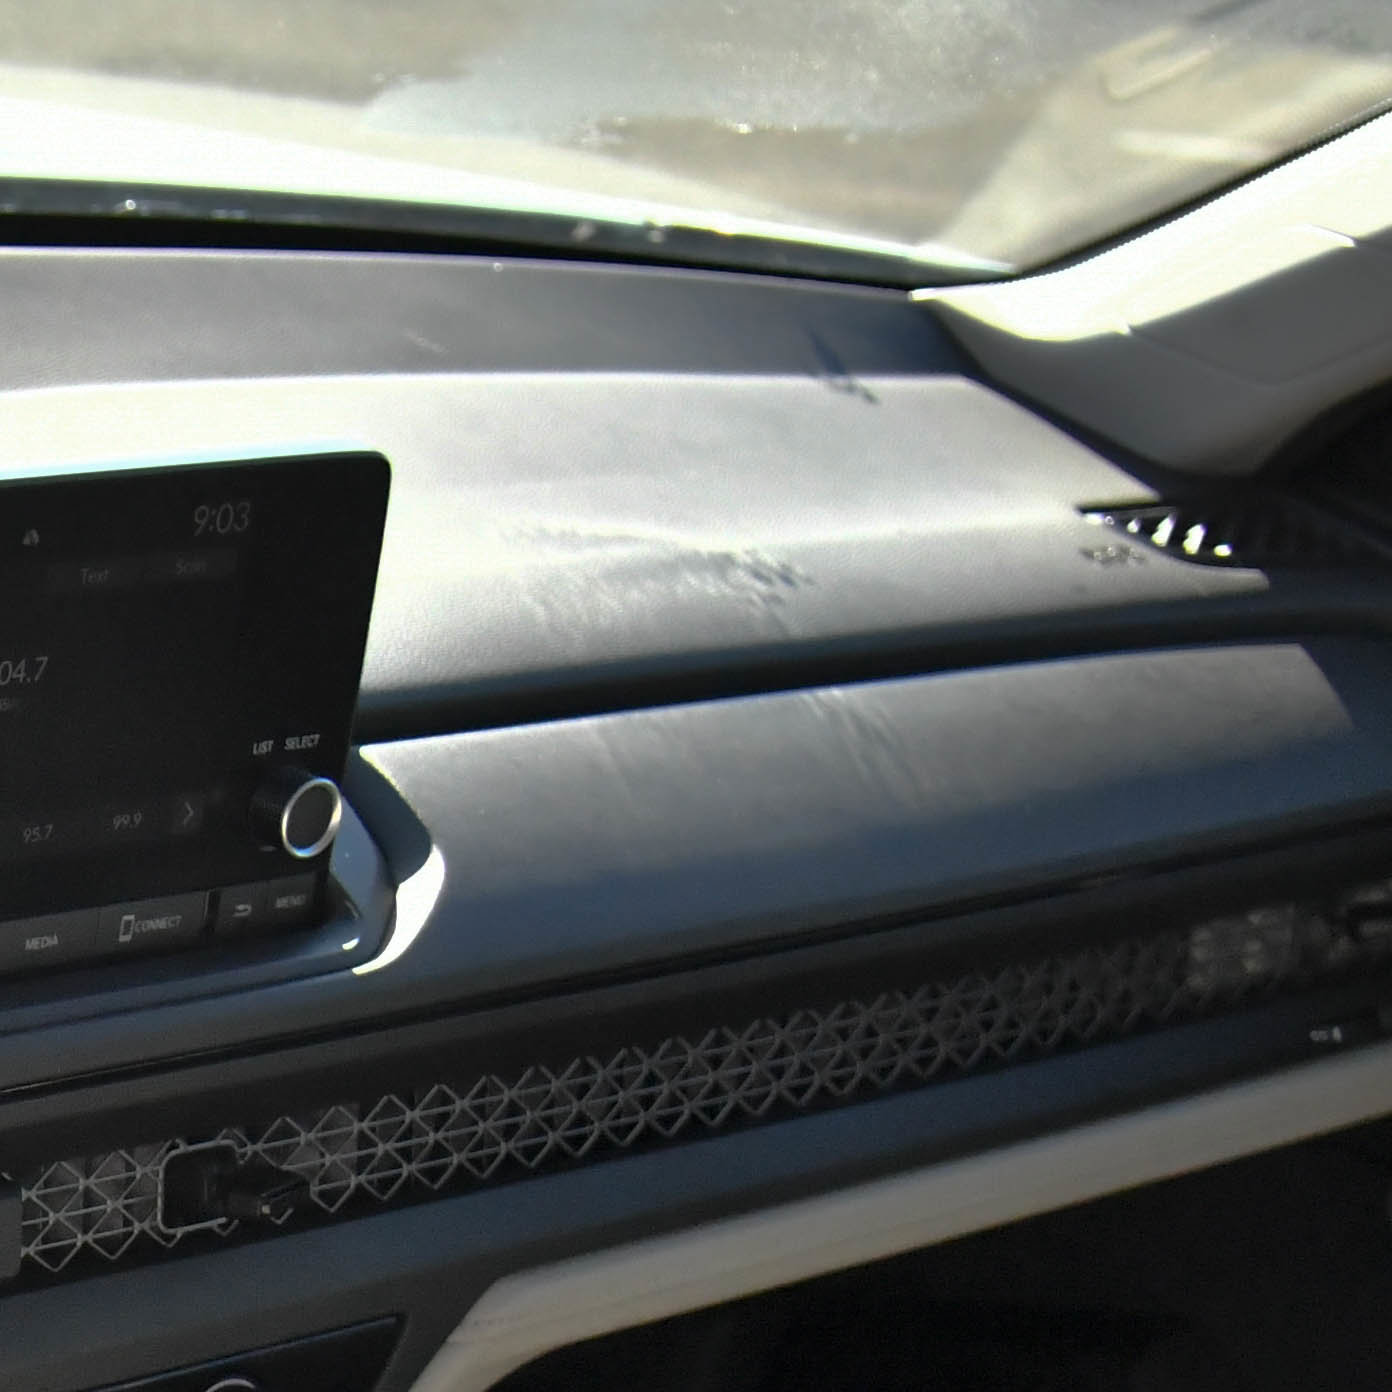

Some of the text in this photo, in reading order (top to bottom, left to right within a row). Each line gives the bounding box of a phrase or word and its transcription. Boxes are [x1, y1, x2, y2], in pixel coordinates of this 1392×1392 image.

[193, 501, 252, 537] 9:03
[80, 567, 111, 586] Text
[252, 733, 321, 756] LIST SELECT
[22, 824, 54, 844] 95.7
[133, 914, 183, 935] CONNECT
[24, 933, 59, 951] MEDIA
